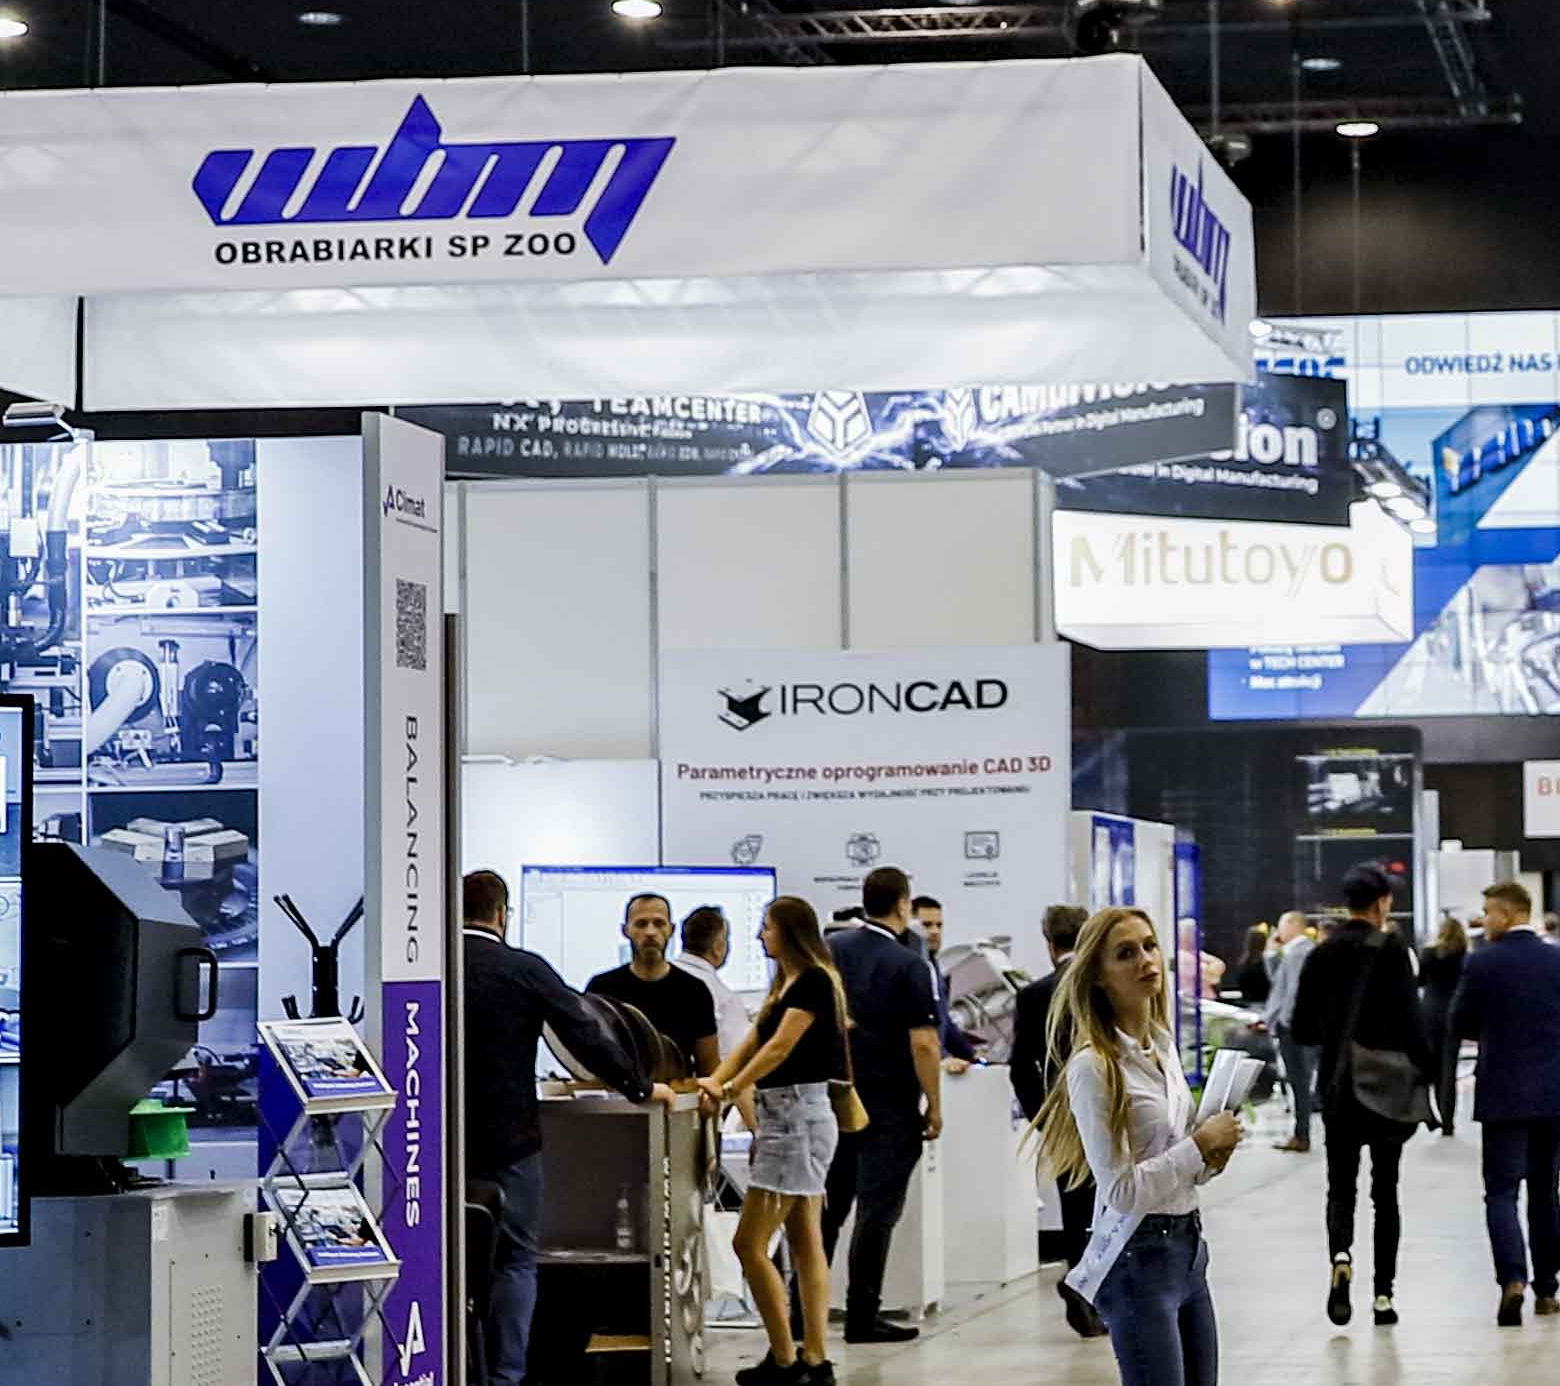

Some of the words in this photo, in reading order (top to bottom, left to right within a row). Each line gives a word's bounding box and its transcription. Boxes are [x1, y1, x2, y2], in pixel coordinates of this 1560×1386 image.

[214, 236, 433, 267] OBRABIARKI
[448, 235, 492, 258] SP
[504, 232, 576, 256] ZOO
[1405, 351, 1502, 375] ODWIEDŹ
[1509, 353, 1552, 373] NAS
[458, 437, 515, 458] RAPID
[1069, 530, 1353, 599] Mitutoyo
[780, 679, 1008, 716] IRONCAD
[677, 763, 817, 781] Parametryczne
[822, 759, 979, 782] oprogramowanie
[983, 757, 1023, 774] CAD
[1027, 756, 1052, 773] 3D
[402, 714, 419, 966] BALANCING
[405, 1001, 421, 1229] MACHINES
